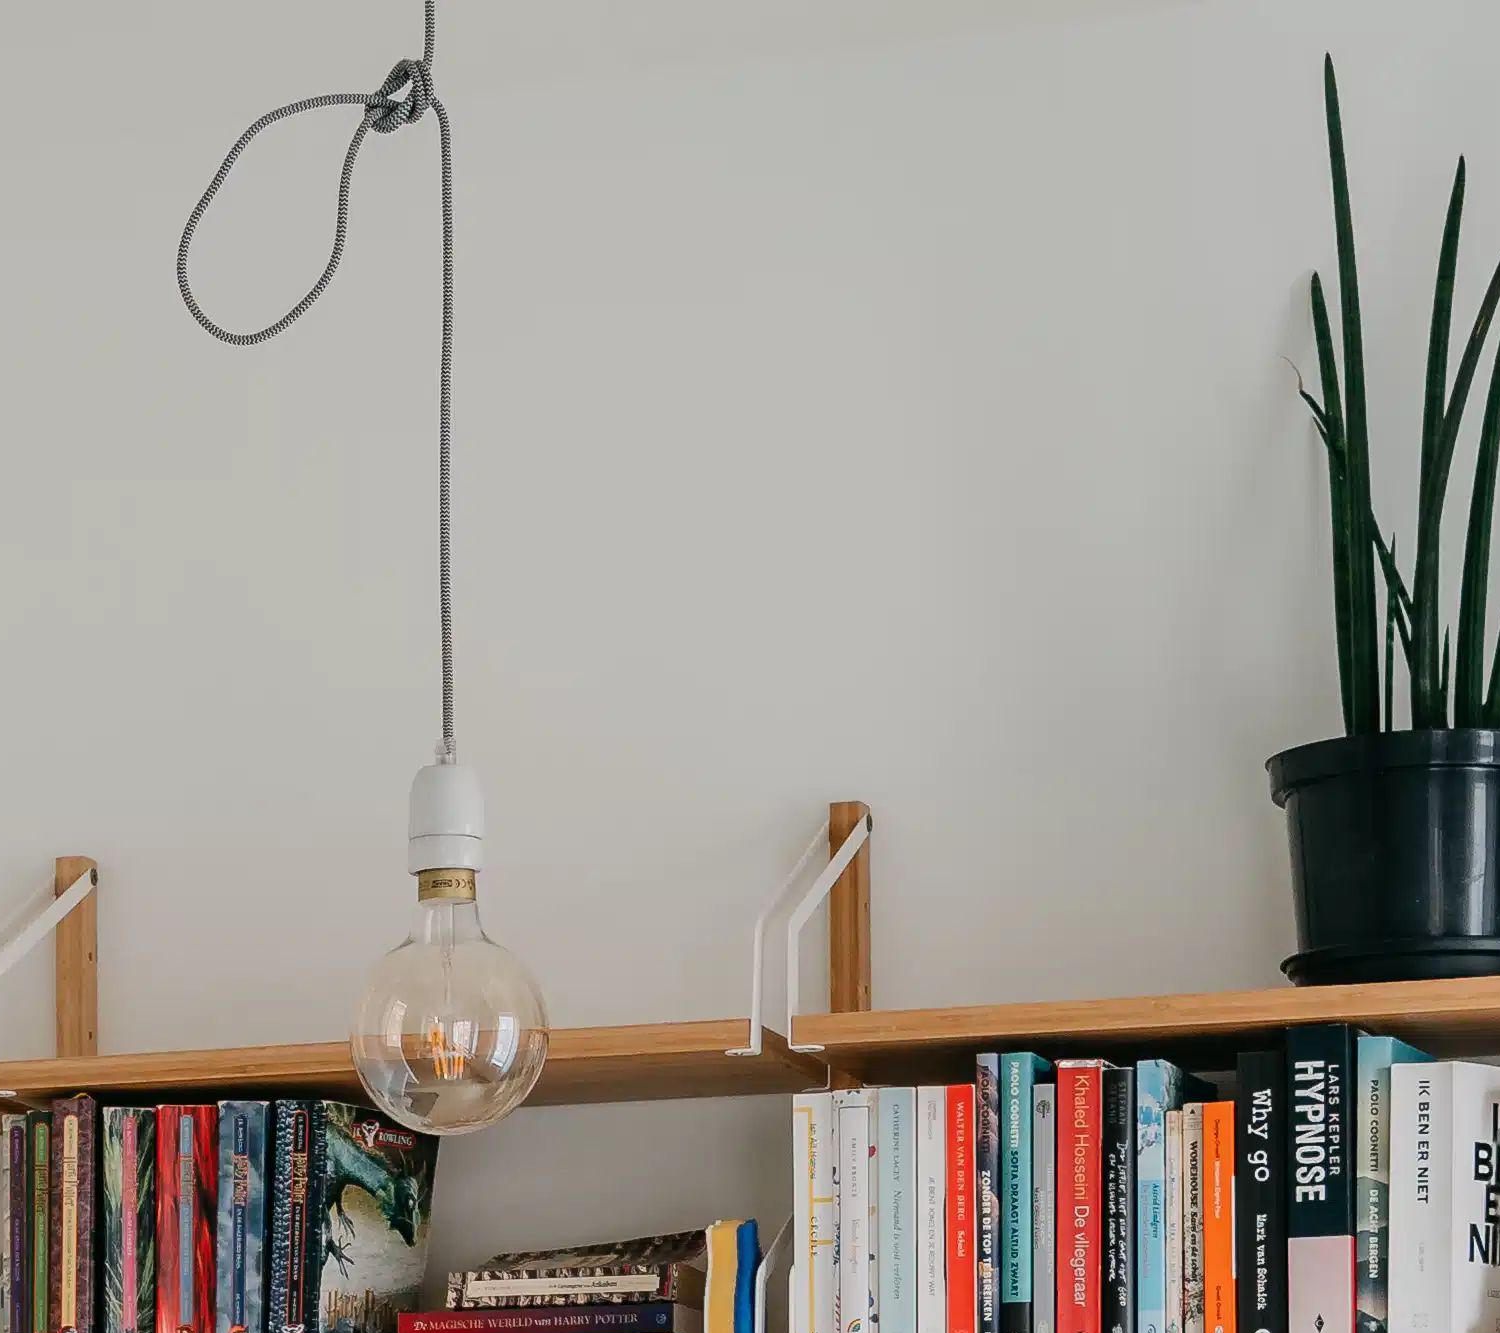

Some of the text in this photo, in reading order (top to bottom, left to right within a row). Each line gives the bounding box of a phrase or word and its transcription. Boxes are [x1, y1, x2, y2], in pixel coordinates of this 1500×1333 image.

[892, 1104, 900, 1150] CATHERINE
[1010, 1062, 1020, 1147] PAOLO COGNETTI
[1074, 1075, 1090, 1202] Khaled Hosseini
[1247, 1088, 1272, 1182] Why go
[1294, 1060, 1326, 1203] HYPNOSE
[1328, 1064, 1341, 1176] LARS KEPLER
[1417, 1080, 1430, 1205] IK BEN ER NIET
[956, 1146, 964, 1165] VAN
[1184, 1141, 1199, 1208] WODEHOUSE
[1369, 1080, 1379, 1279] PAOLO COGNETTI DE BERGEN
[893, 1189, 902, 1232] Niemand
[980, 1170, 992, 1321] ZONDER DE TOP BEREIKEN
[1010, 1150, 1018, 1297] SOFIA DRAAGT ALTIJD ZWART
[1071, 1205, 1090, 1307] De vliegeraar
[1256, 1213, 1267, 1266] Mark van
[429, 1312, 638, 1330] MAGISCHE WERELD HARRY POTTER
